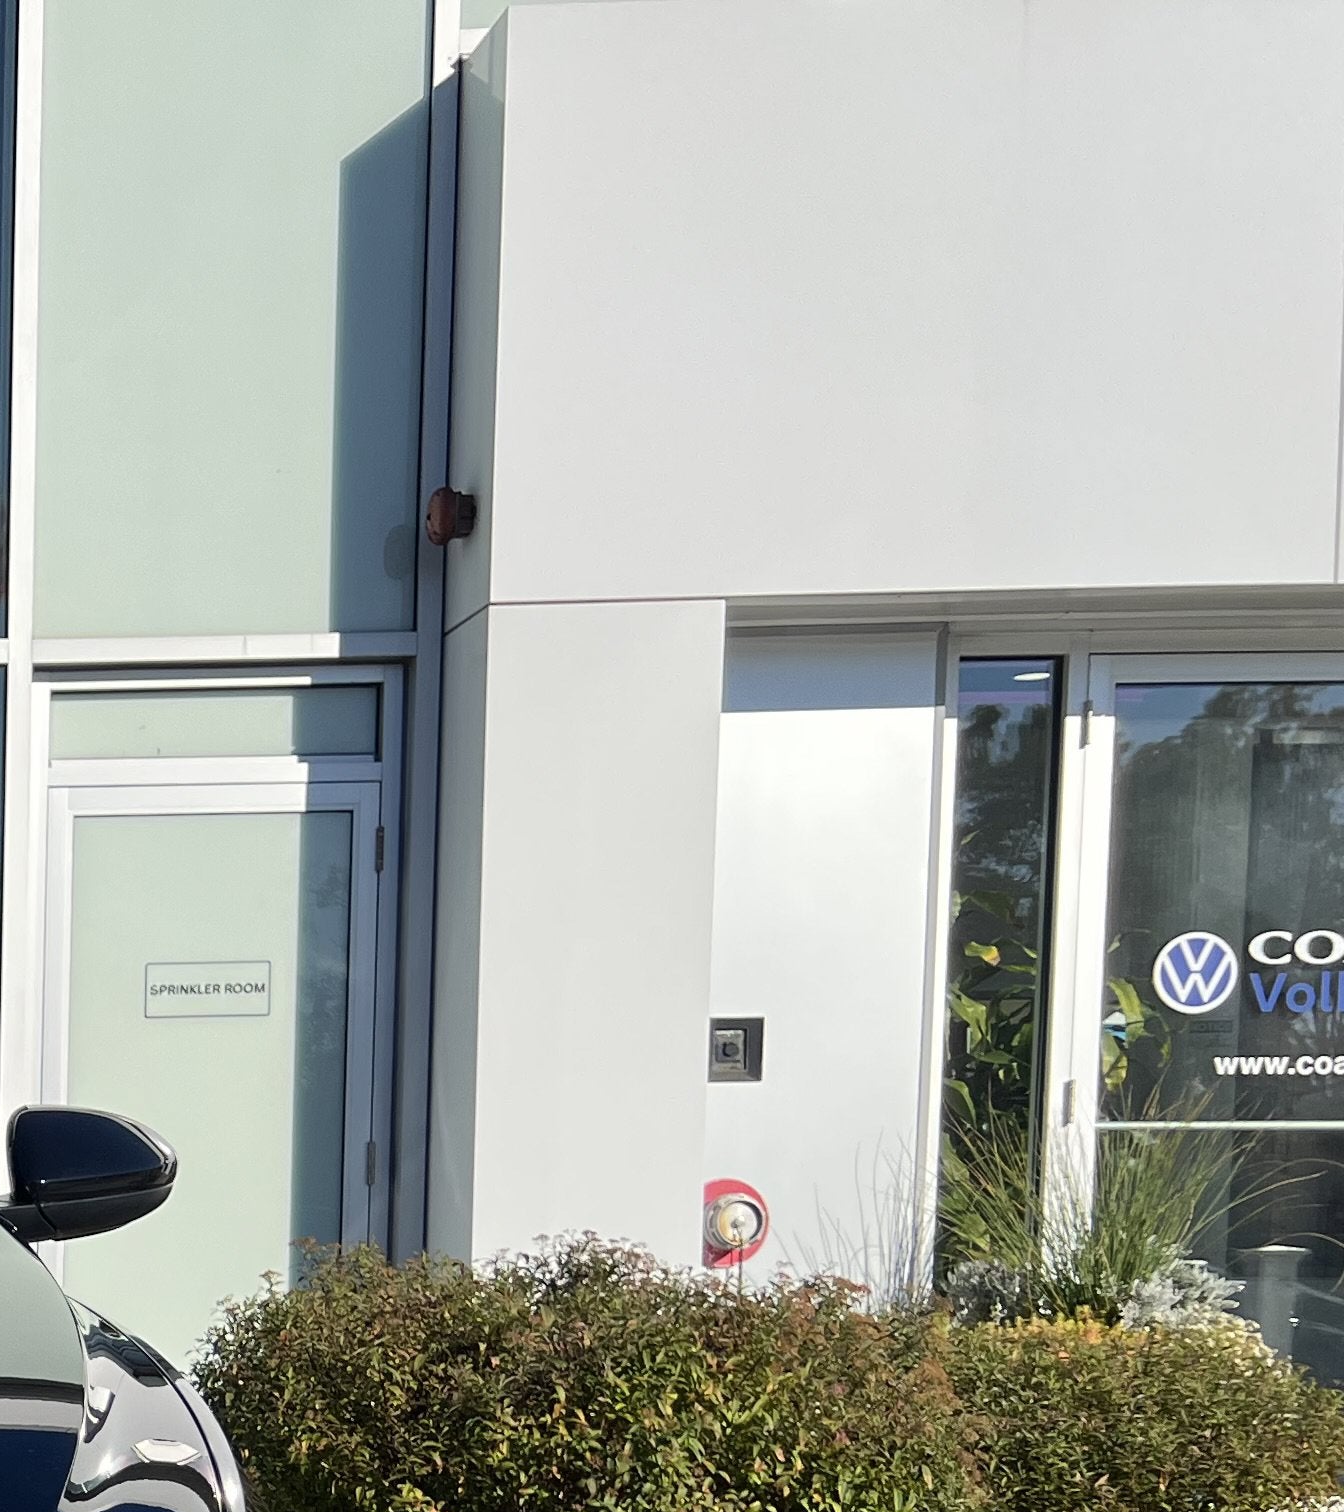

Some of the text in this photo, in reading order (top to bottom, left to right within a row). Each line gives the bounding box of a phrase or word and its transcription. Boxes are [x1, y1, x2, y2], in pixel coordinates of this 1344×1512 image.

[1248, 930, 1344, 965] CO
[150, 983, 266, 995] SPRINKLER ROOM
